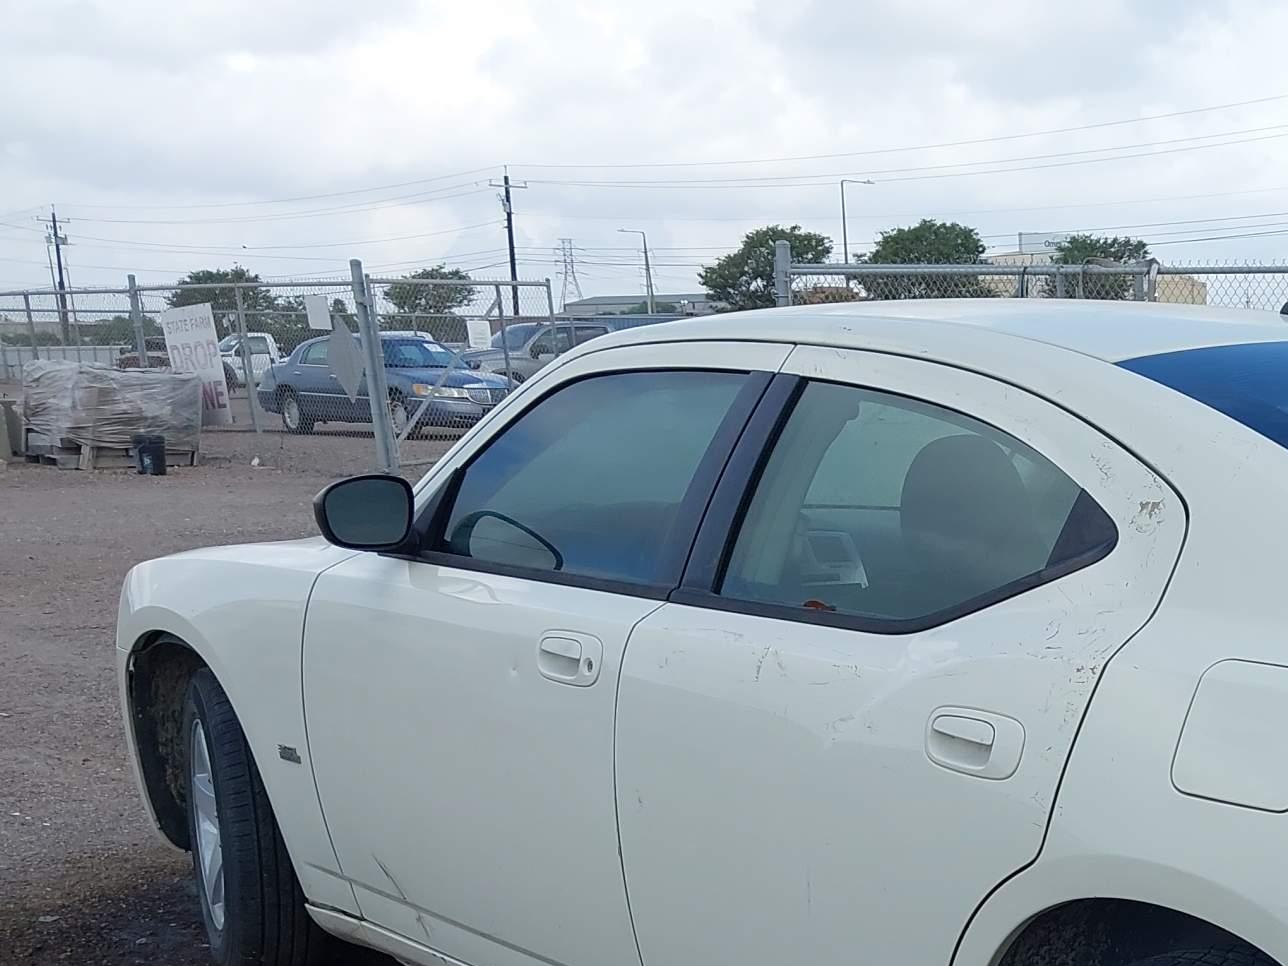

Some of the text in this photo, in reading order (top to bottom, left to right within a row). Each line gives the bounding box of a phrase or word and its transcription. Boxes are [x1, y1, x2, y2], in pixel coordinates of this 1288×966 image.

[166, 318, 189, 335] STATE
[169, 339, 218, 371] DROP
[202, 379, 228, 410] NE
